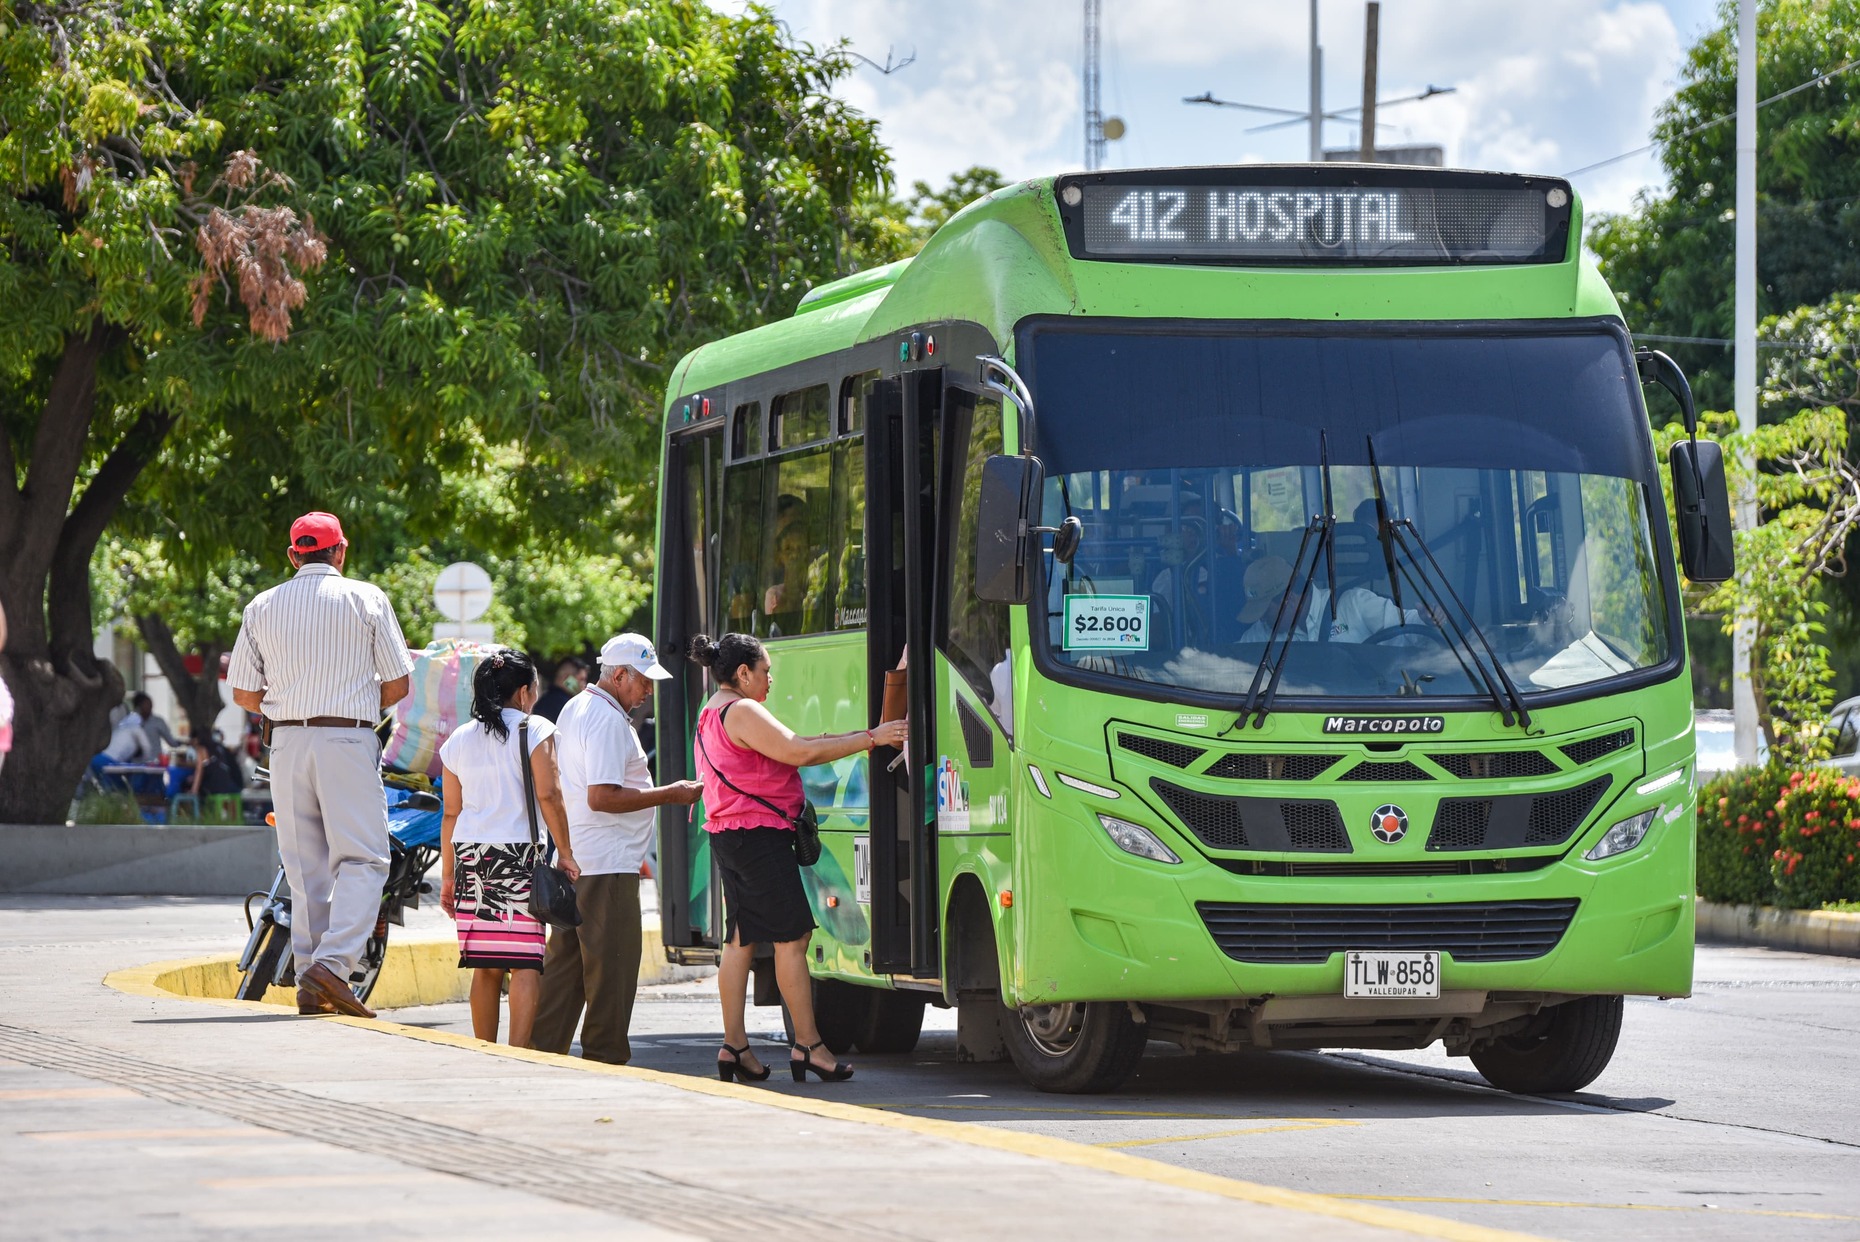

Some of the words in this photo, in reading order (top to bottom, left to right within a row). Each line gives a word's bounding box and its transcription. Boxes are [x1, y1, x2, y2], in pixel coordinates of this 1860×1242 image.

[1110, 191, 1186, 240] 412
[1209, 191, 1416, 241] HOSPITAL
[1075, 614, 1142, 634] $2.600
[1326, 717, 1443, 734] Marcopolo
[938, 771, 964, 812] SIVA
